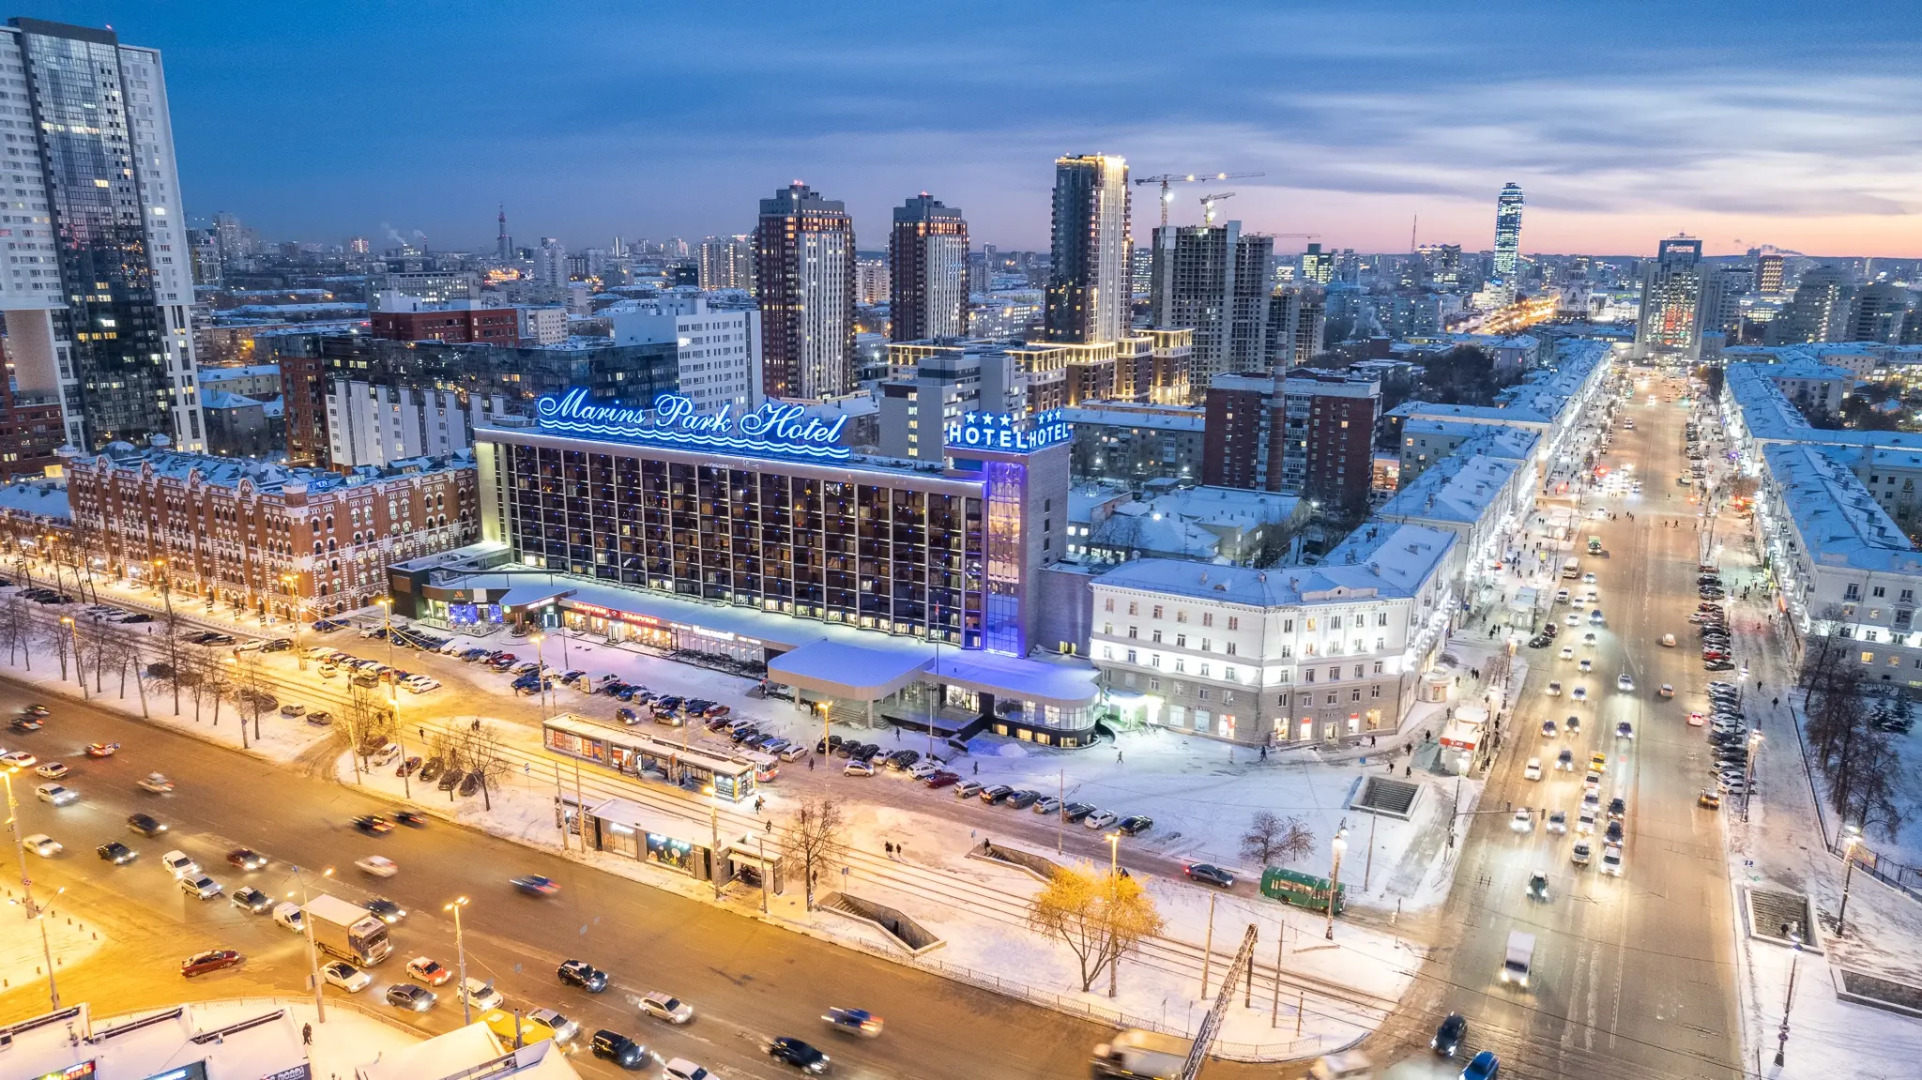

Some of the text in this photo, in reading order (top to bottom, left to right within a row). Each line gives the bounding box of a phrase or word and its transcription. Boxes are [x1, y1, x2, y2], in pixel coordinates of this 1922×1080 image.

[538, 388, 848, 443] Marins Park Hotel
[949, 425, 1028, 449] HOTEL
[1029, 422, 1069, 448] HOTEL
